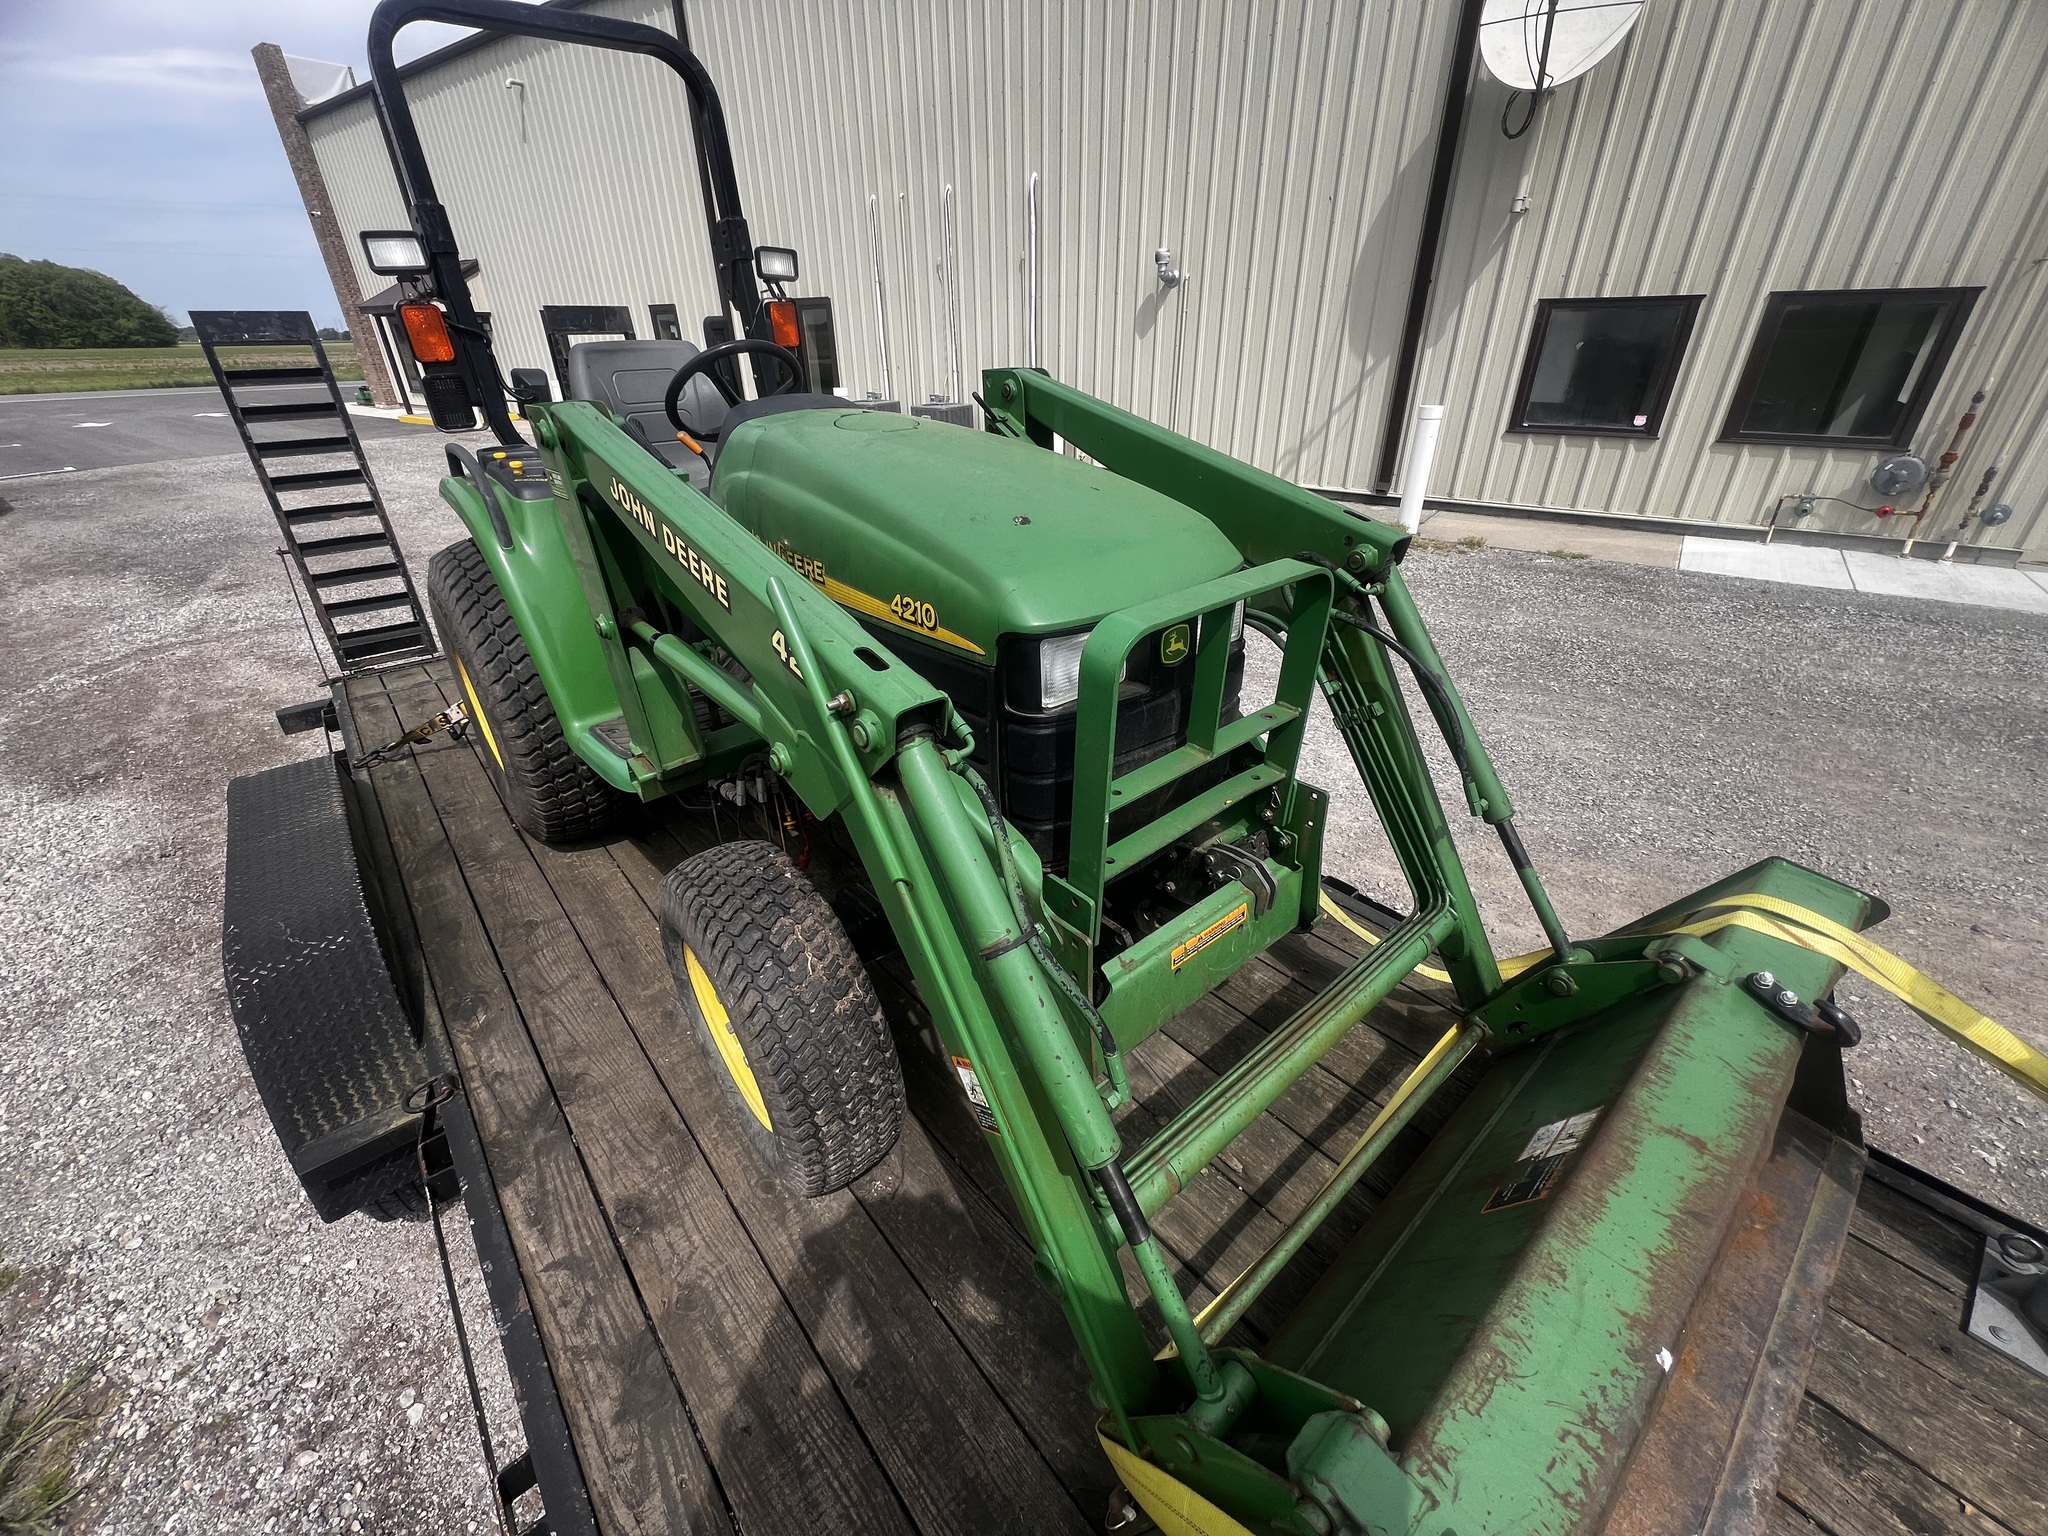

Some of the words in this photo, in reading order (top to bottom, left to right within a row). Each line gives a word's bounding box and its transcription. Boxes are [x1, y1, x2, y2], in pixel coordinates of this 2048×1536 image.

[609, 476, 658, 539] JOHN
[661, 522, 731, 611] DEERE
[890, 593, 938, 631] 4210
